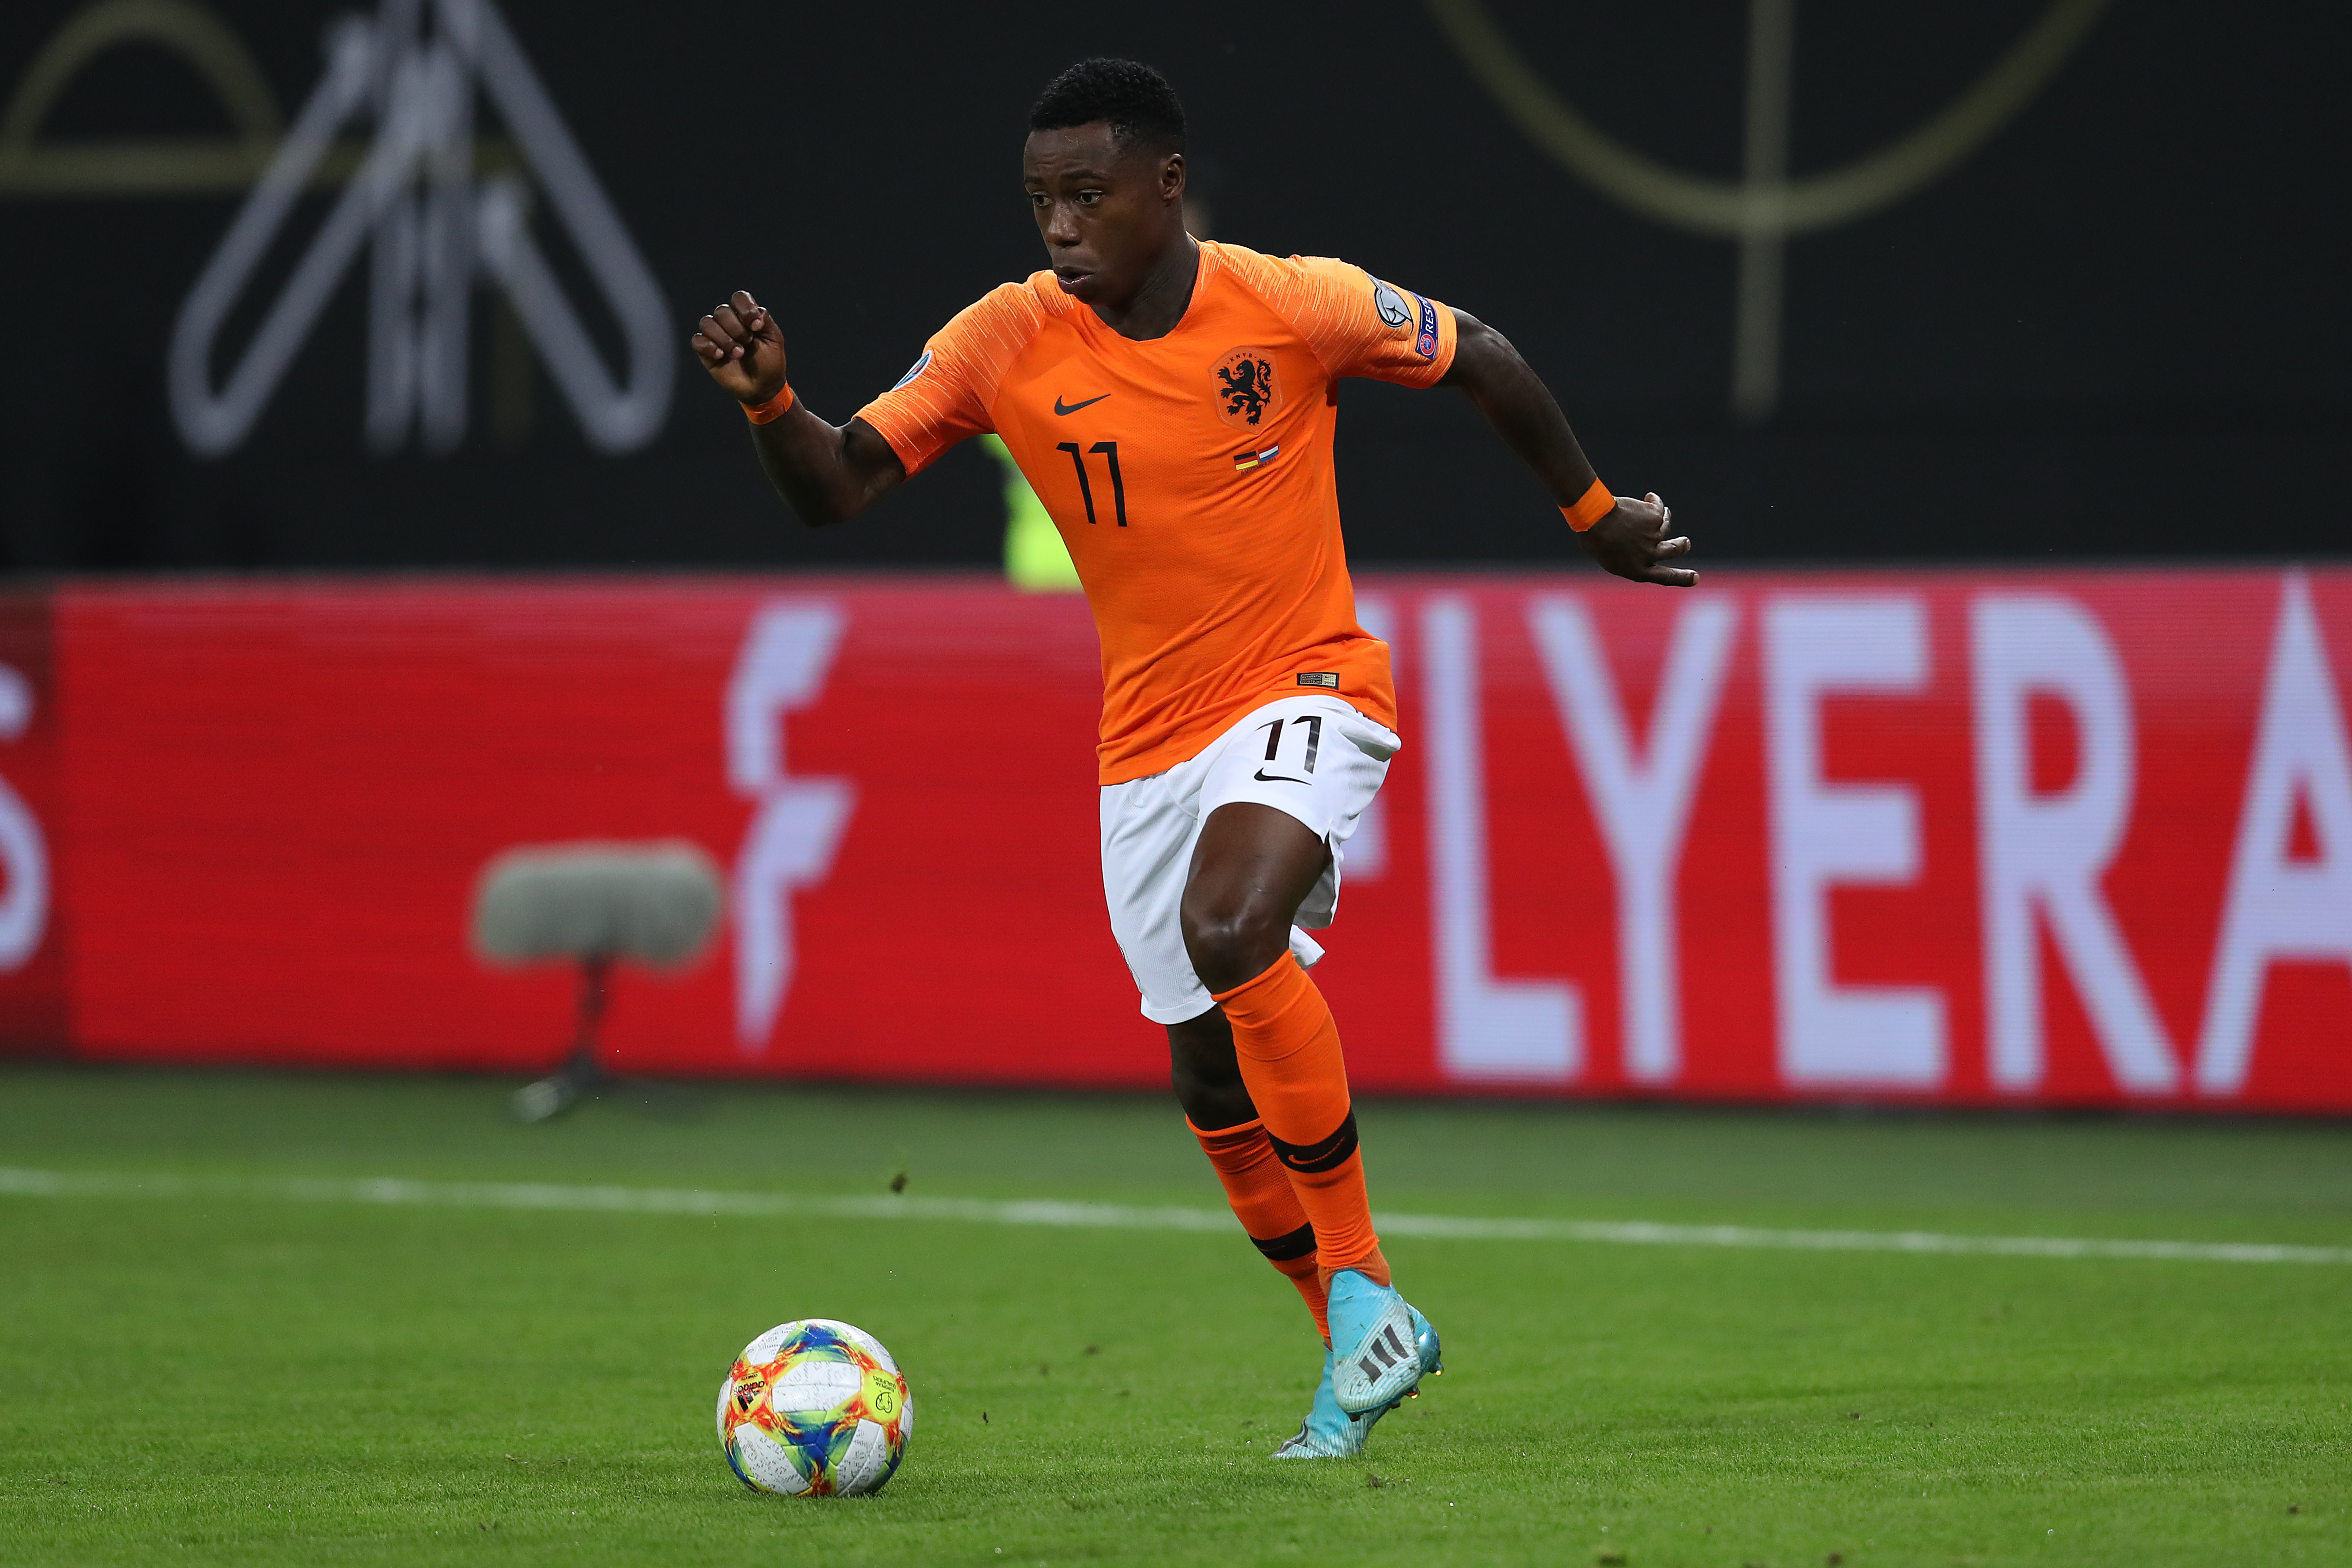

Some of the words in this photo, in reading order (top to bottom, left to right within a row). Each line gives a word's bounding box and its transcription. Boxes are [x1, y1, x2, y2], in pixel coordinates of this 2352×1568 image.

[1230, 353, 1252, 362] KNVB
[1056, 441, 1127, 527] 11
[1254, 715, 1322, 774] 11
[1341, 574, 2352, 1092] LYERA
